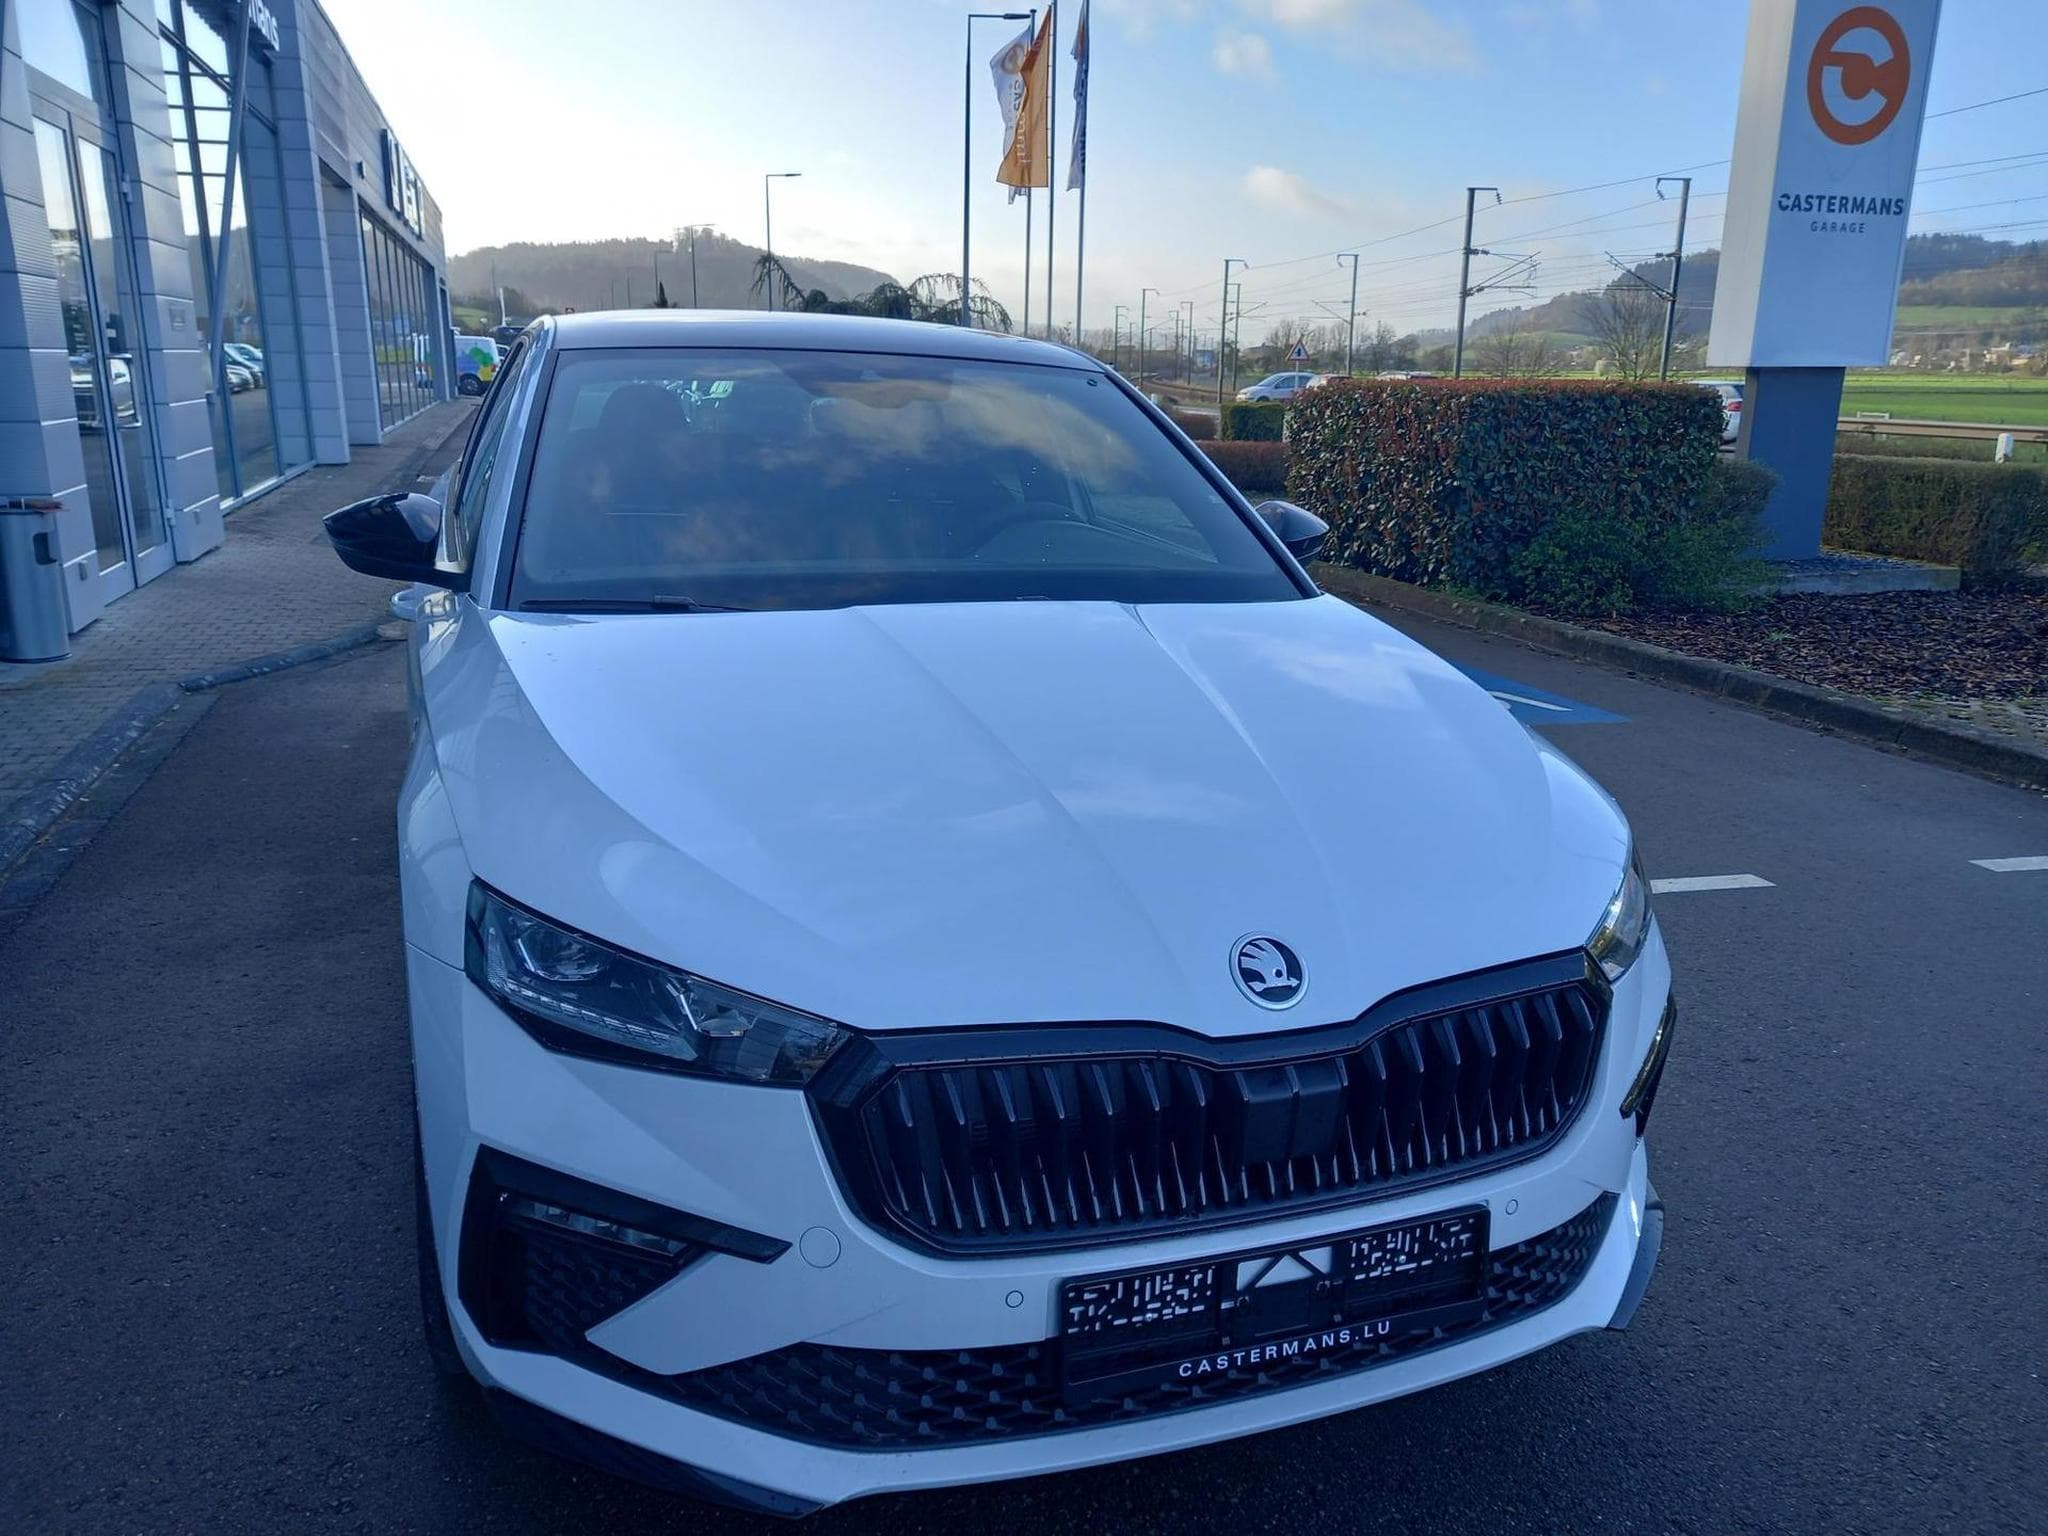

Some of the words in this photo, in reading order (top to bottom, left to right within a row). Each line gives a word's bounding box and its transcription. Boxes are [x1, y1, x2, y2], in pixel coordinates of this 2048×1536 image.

[1778, 193, 1905, 216] CASTERMANS
[1810, 221, 1865, 233] GARAGE
[1179, 1321, 1390, 1377] CASTERMANS.LU
